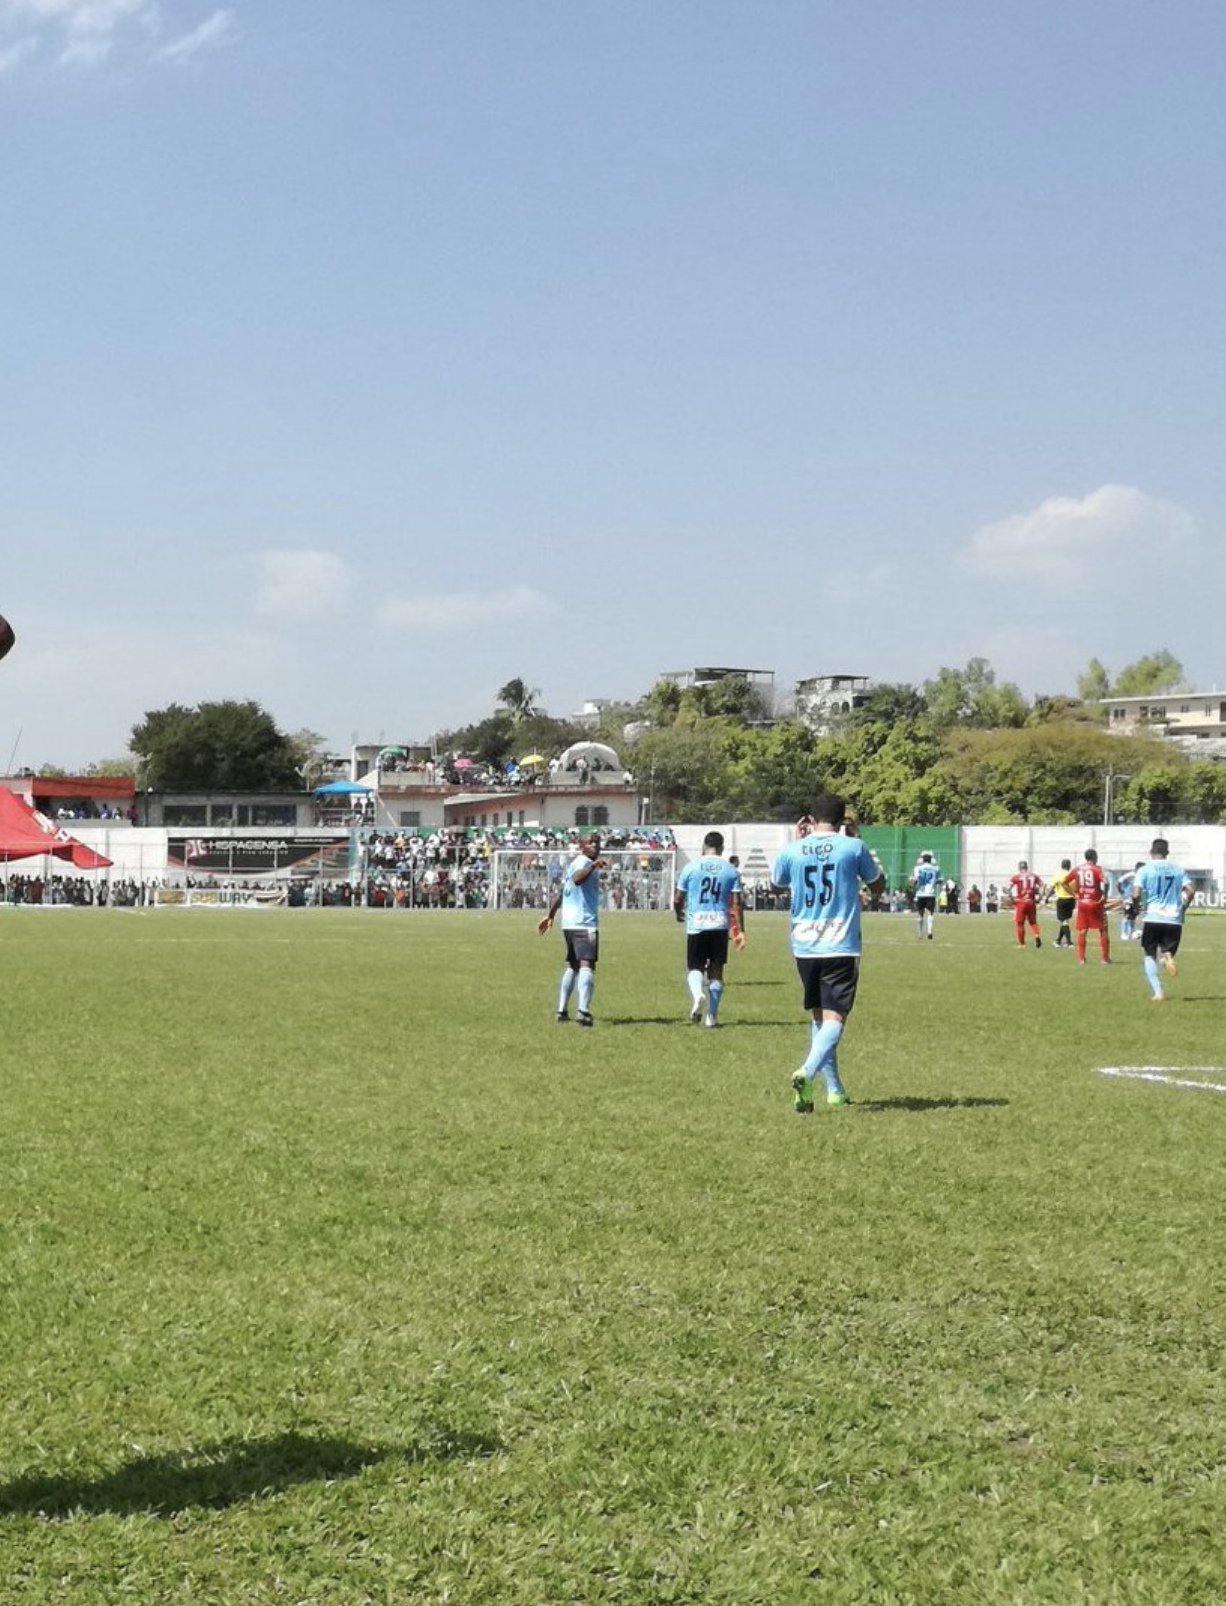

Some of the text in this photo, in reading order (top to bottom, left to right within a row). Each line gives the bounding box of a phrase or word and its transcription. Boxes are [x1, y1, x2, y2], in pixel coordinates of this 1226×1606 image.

[802, 843, 834, 861] tigo
[803, 863, 835, 909] 55
[1077, 869, 1094, 888] 19
[1156, 875, 1175, 900] 17
[190, 892, 252, 904] SUBWAY
[699, 876, 722, 904] 24
